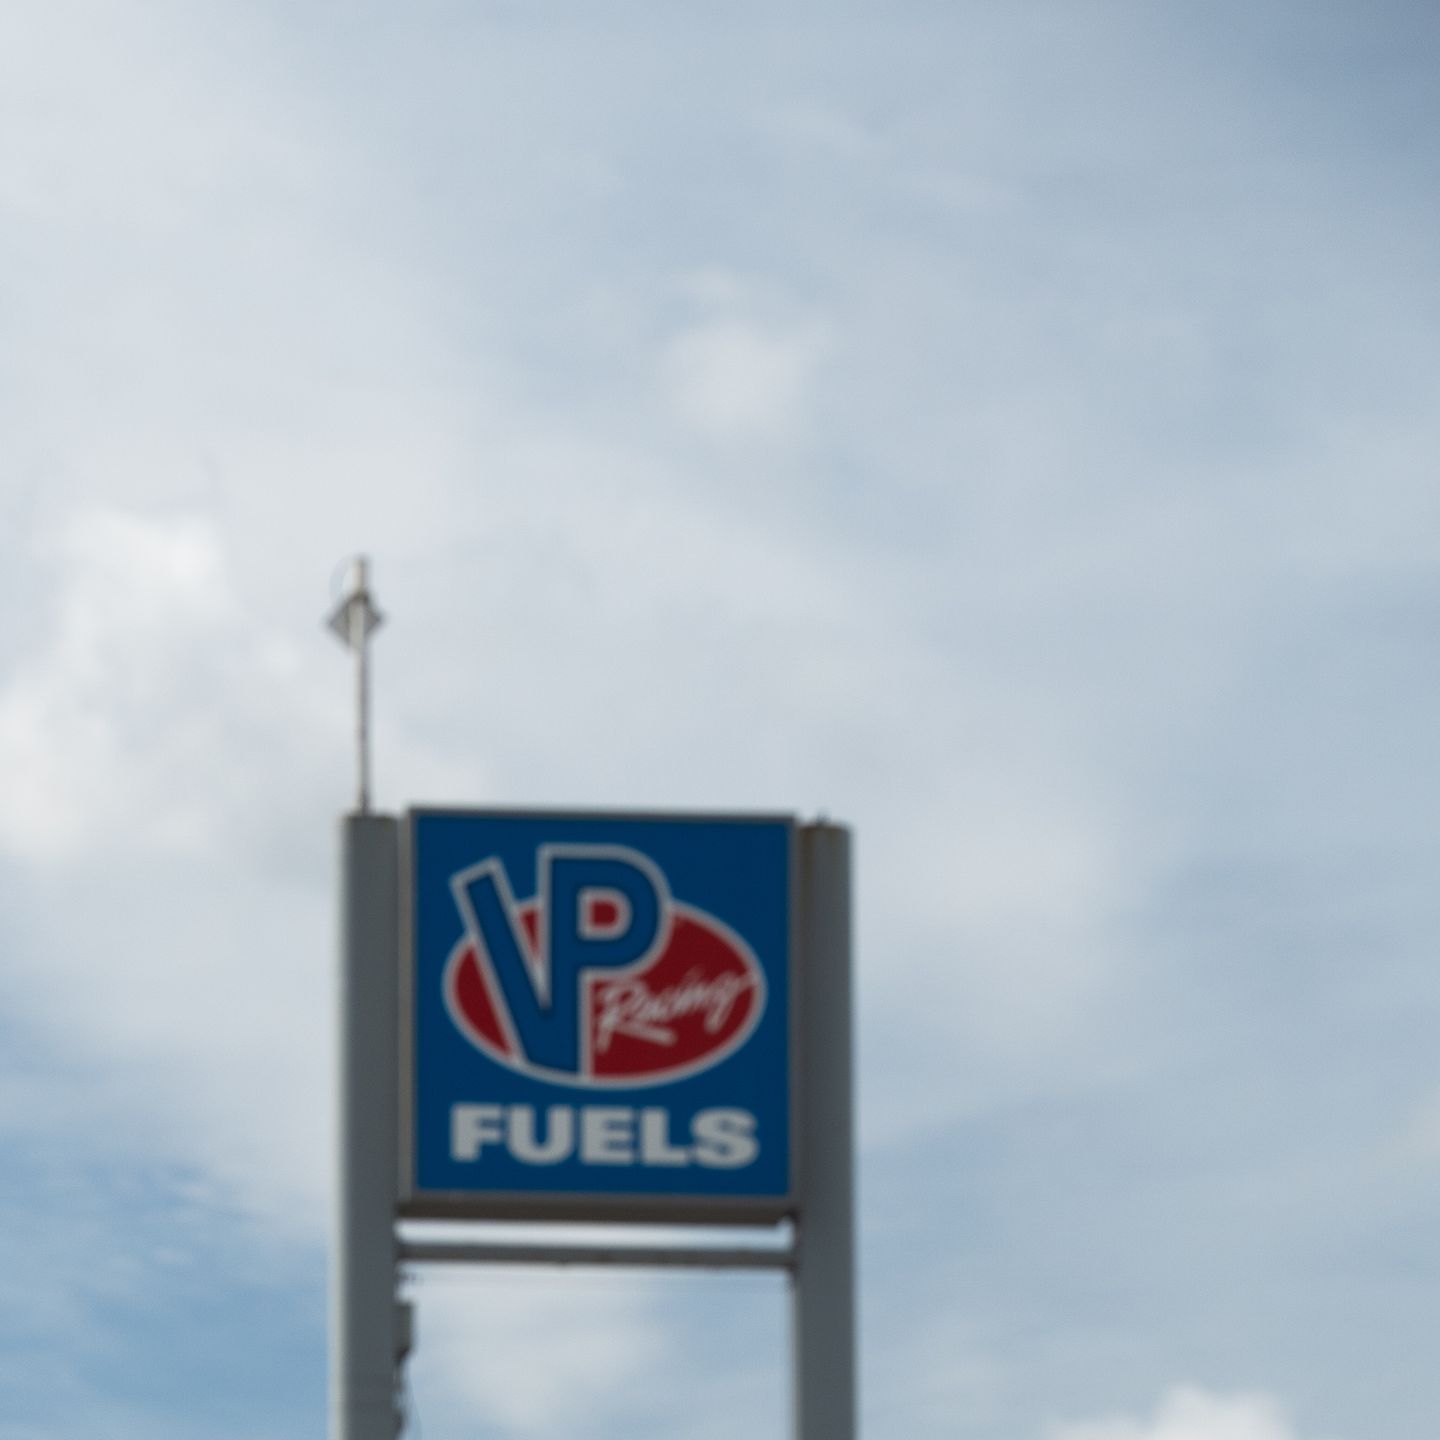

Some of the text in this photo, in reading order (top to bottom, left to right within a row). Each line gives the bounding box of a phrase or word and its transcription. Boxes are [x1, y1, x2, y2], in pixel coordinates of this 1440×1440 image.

[449, 843, 671, 1083] VP
[595, 963, 756, 1054] Racing
[450, 1103, 759, 1169] FUELS
